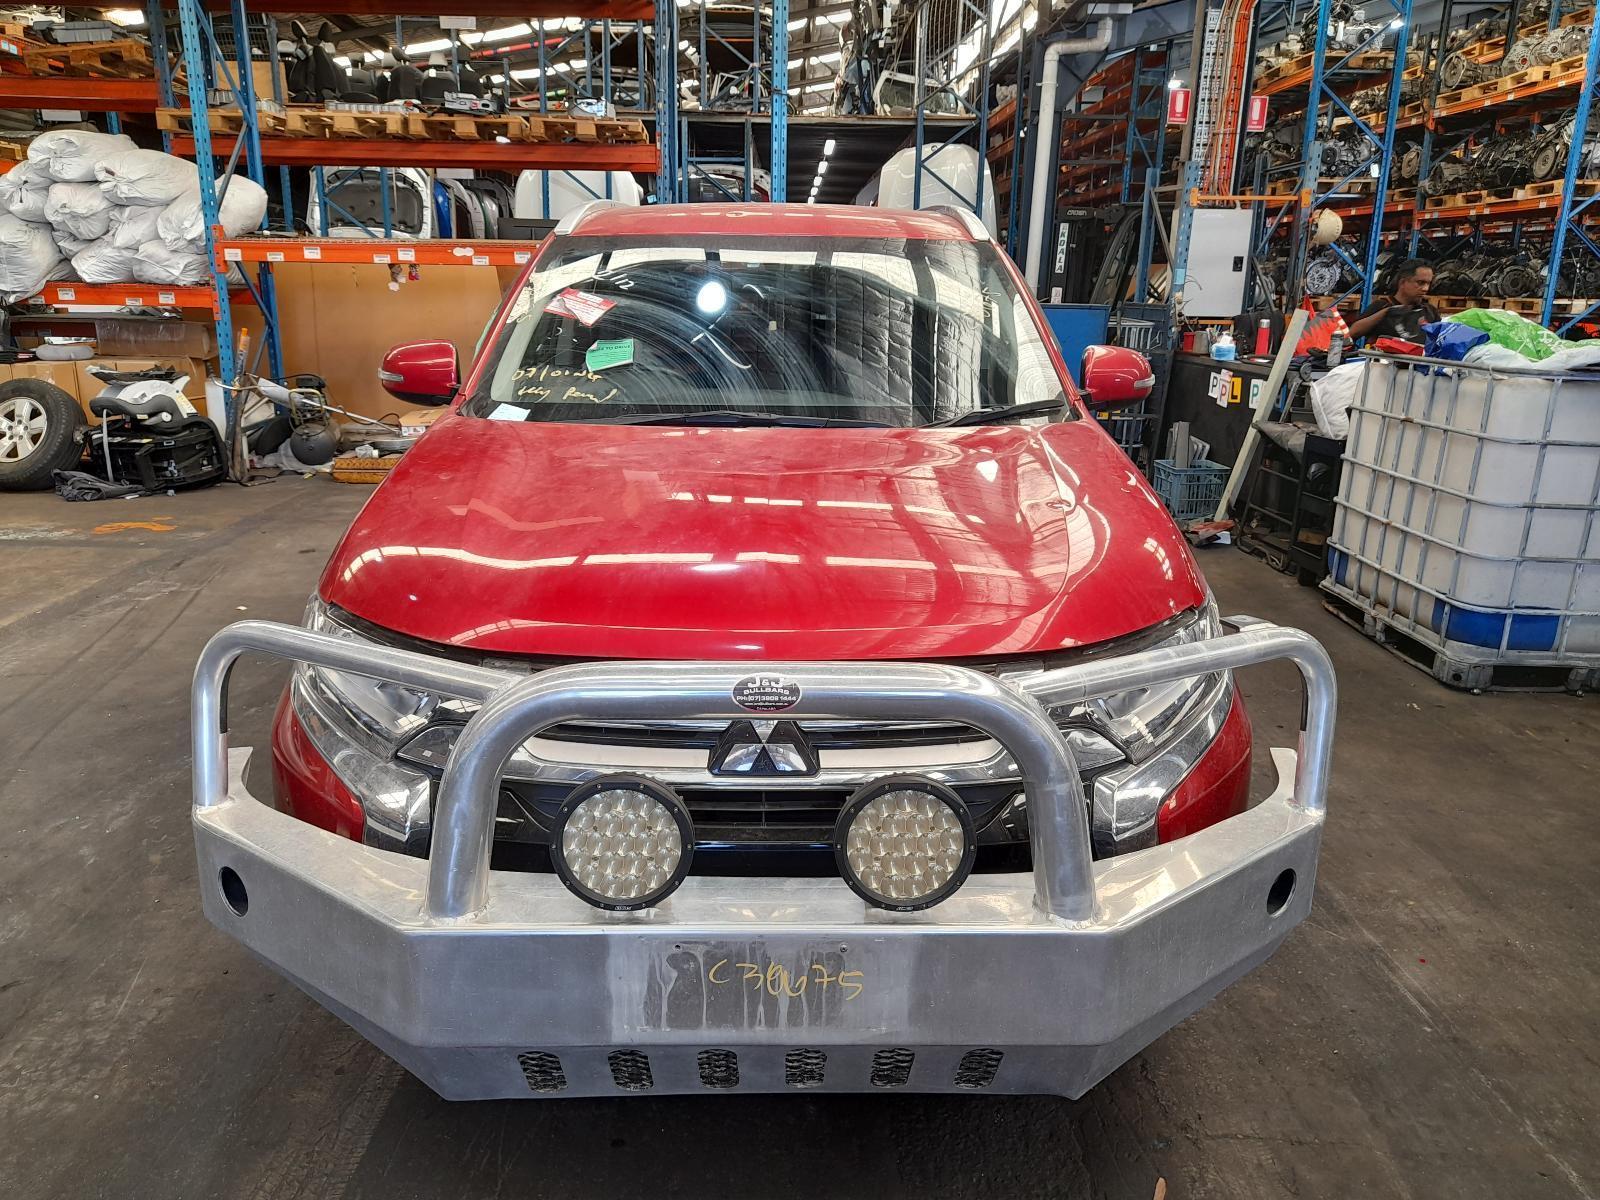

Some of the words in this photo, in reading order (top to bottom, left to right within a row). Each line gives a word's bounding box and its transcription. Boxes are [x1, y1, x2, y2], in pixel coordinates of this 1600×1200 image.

[1230, 381, 1239, 400] L
[1251, 384, 1260, 405] P
[743, 687, 790, 695] BULLBARS
